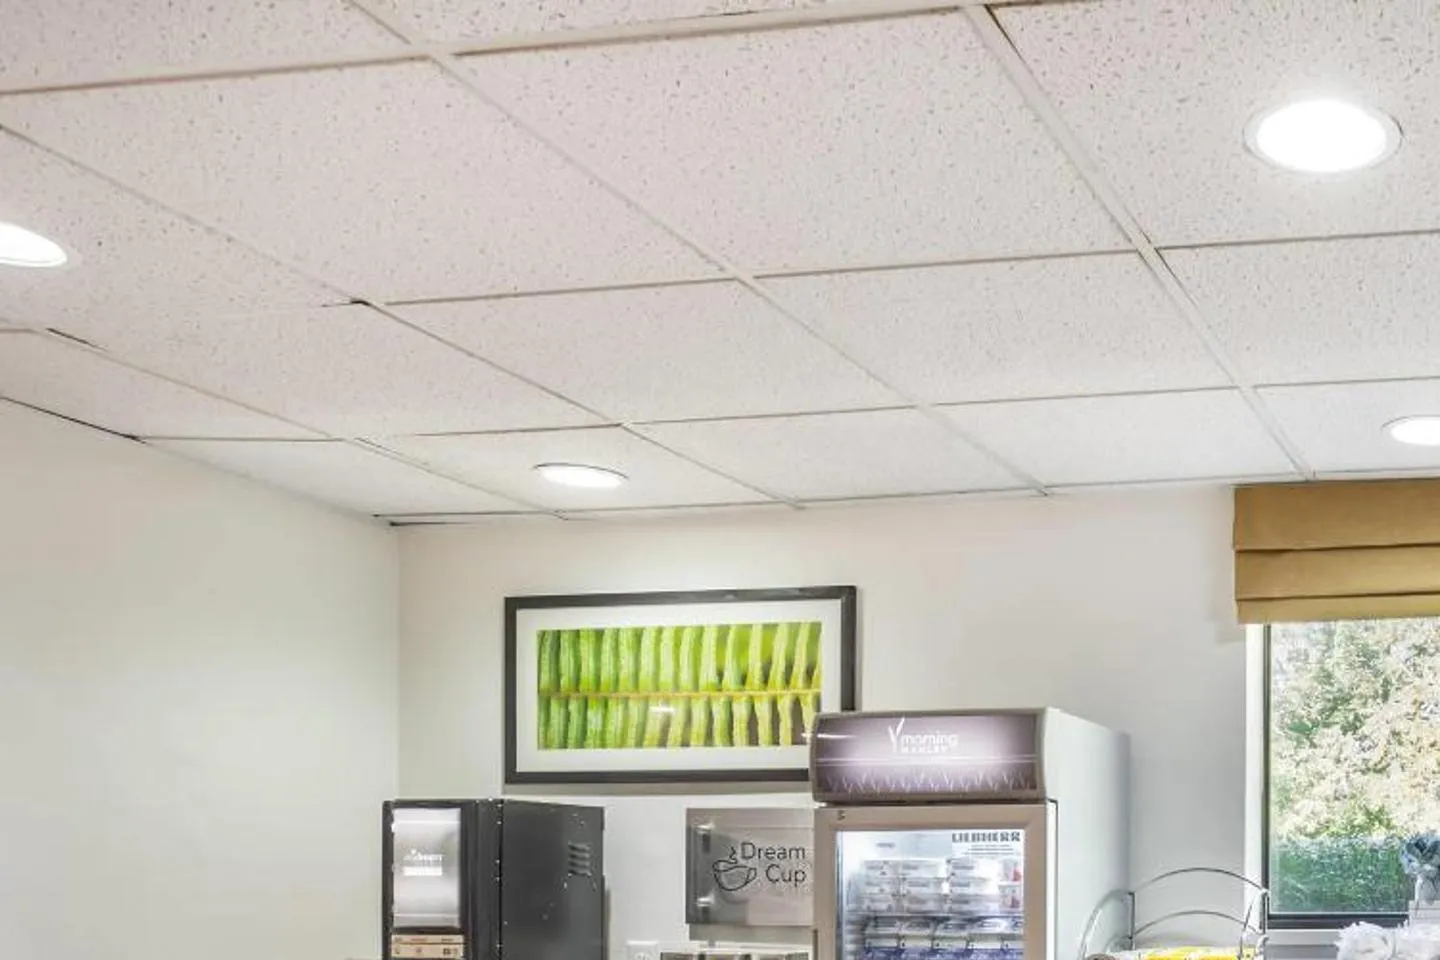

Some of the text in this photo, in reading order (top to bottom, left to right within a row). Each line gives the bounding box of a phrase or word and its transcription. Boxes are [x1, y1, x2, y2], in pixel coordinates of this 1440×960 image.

[901, 731, 959, 749] morning
[741, 842, 806, 860] Dream
[765, 864, 807, 888] Cup
